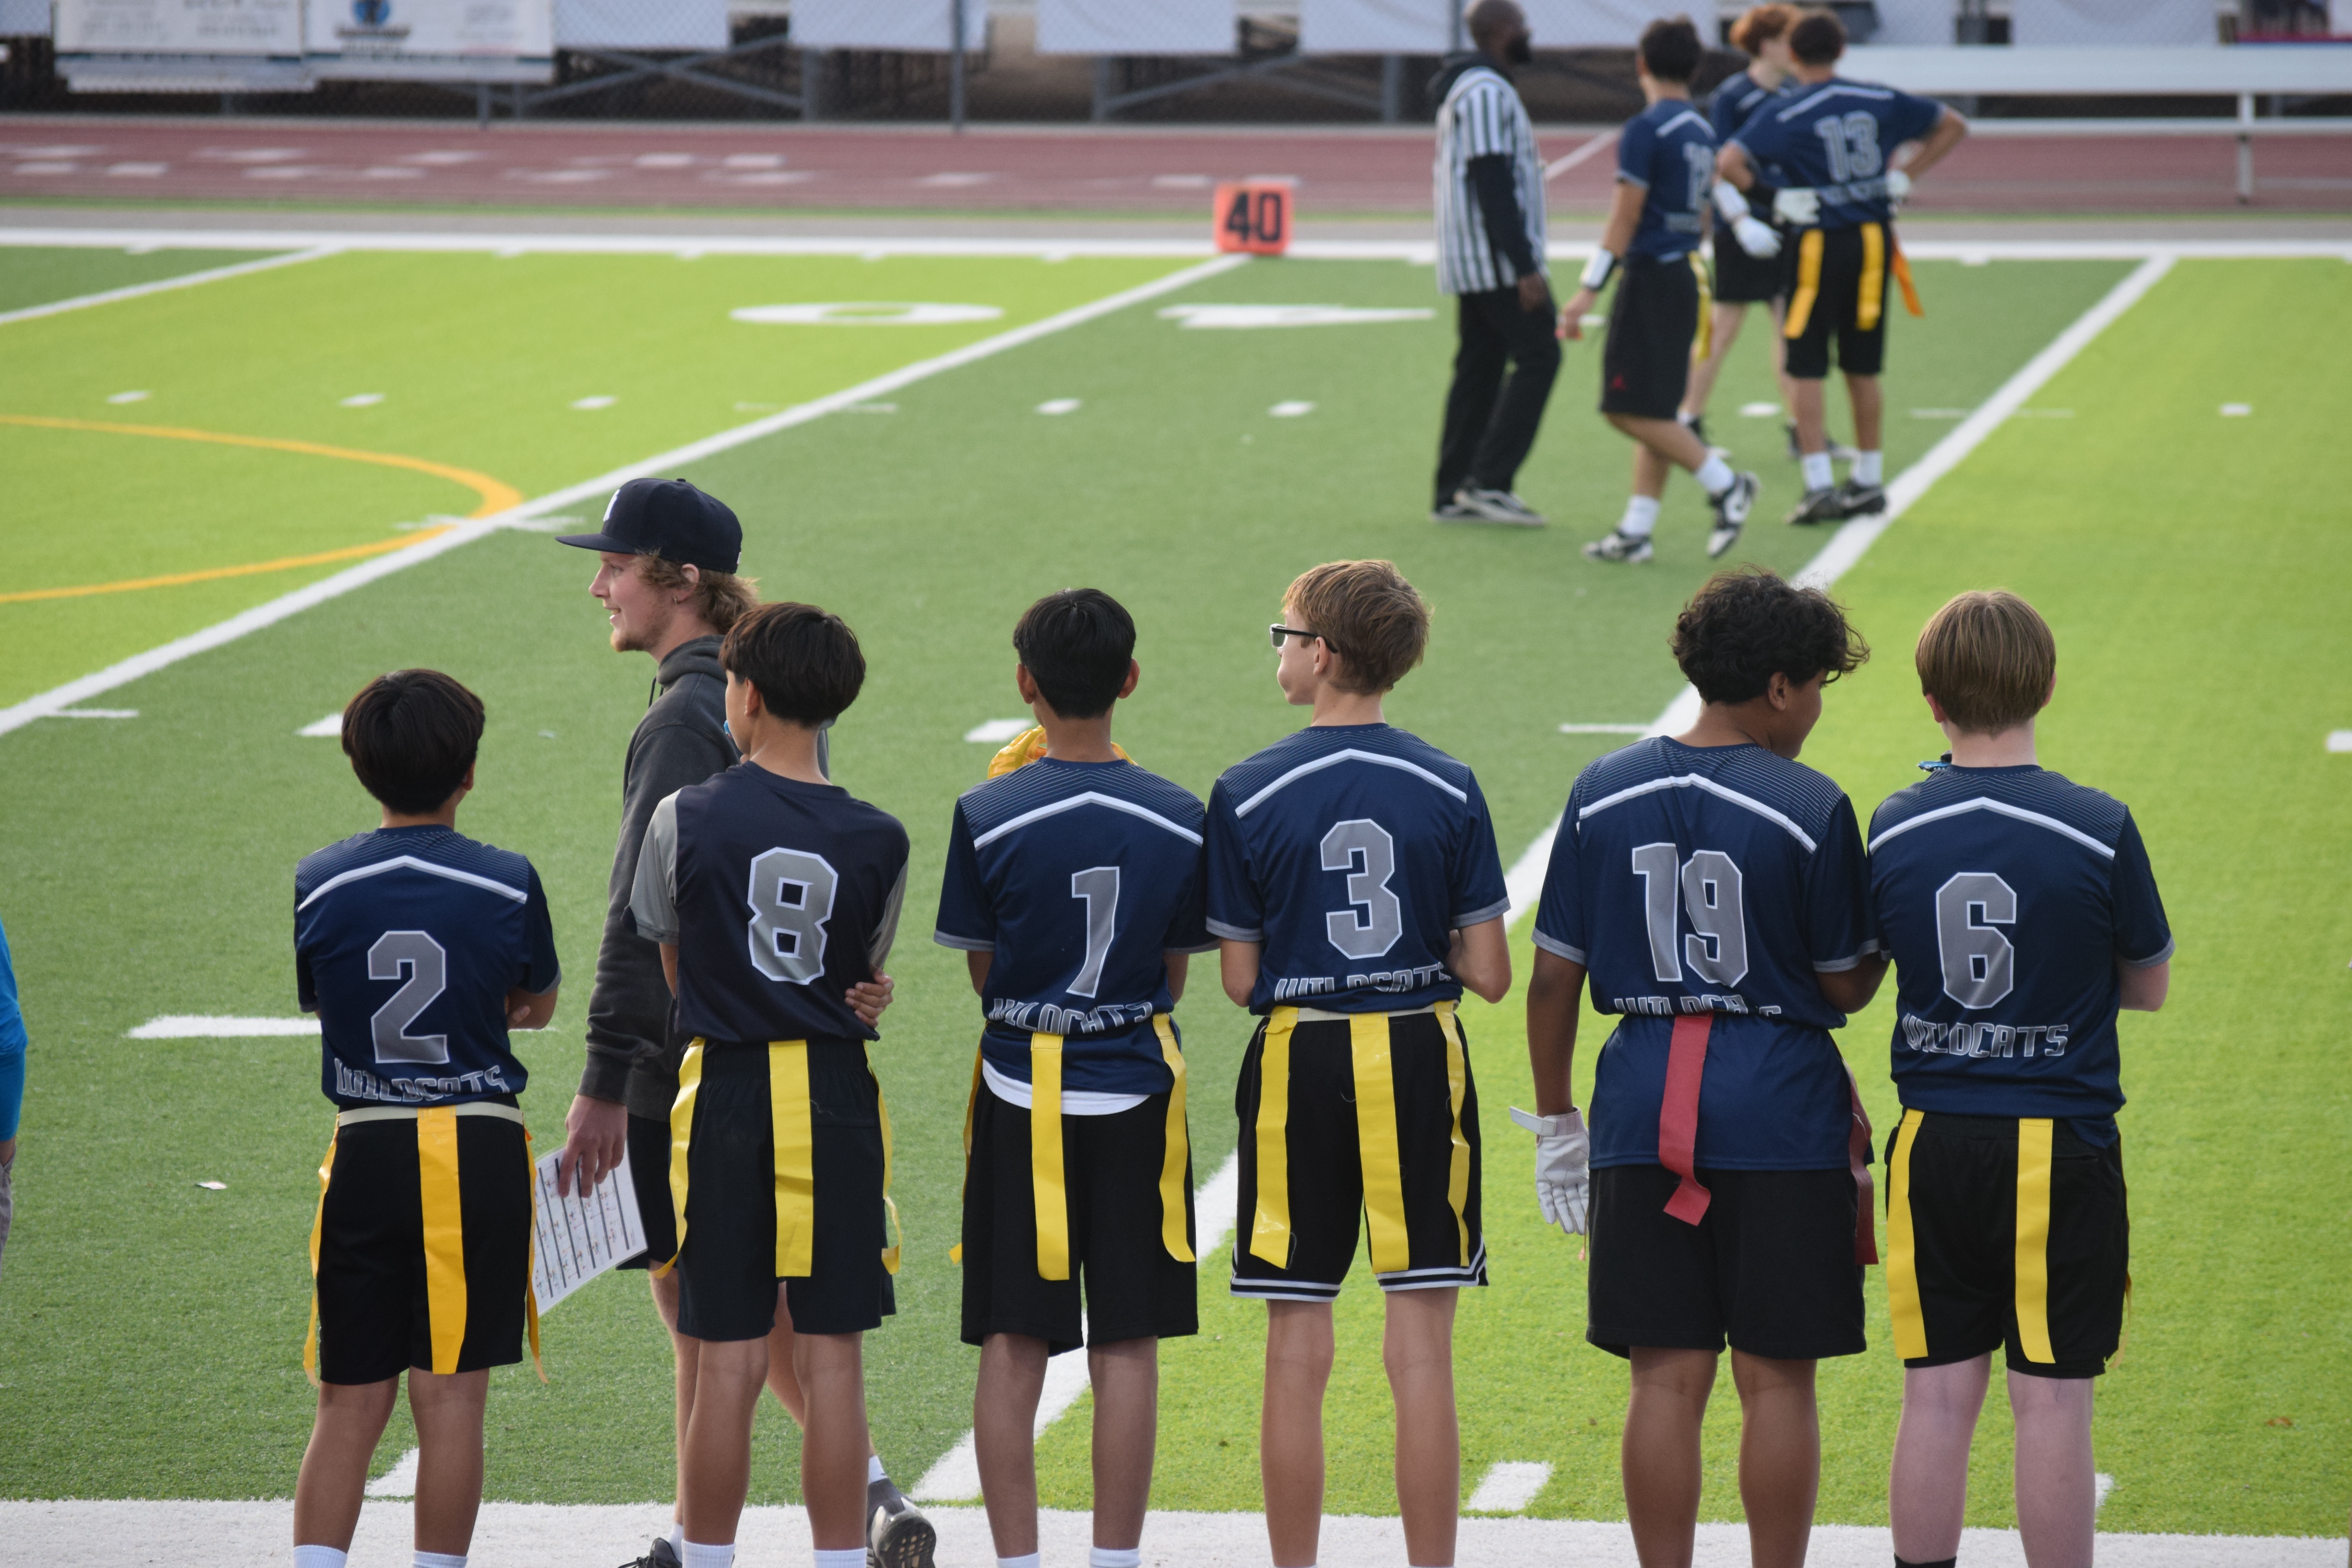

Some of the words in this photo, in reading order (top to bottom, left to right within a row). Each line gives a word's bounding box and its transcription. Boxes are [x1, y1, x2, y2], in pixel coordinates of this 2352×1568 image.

[1813, 111, 1882, 182] 13
[1225, 191, 1281, 243] 40
[747, 847, 838, 985] 8
[1065, 866, 1120, 998] 1
[1320, 818, 1403, 960] 3
[1632, 842, 1748, 988] 19
[1936, 872, 2017, 1009] 6
[368, 930, 450, 1063] 2
[1902, 1012, 2069, 1058] WILDCATS
[334, 1058, 510, 1102] WILDCATS
